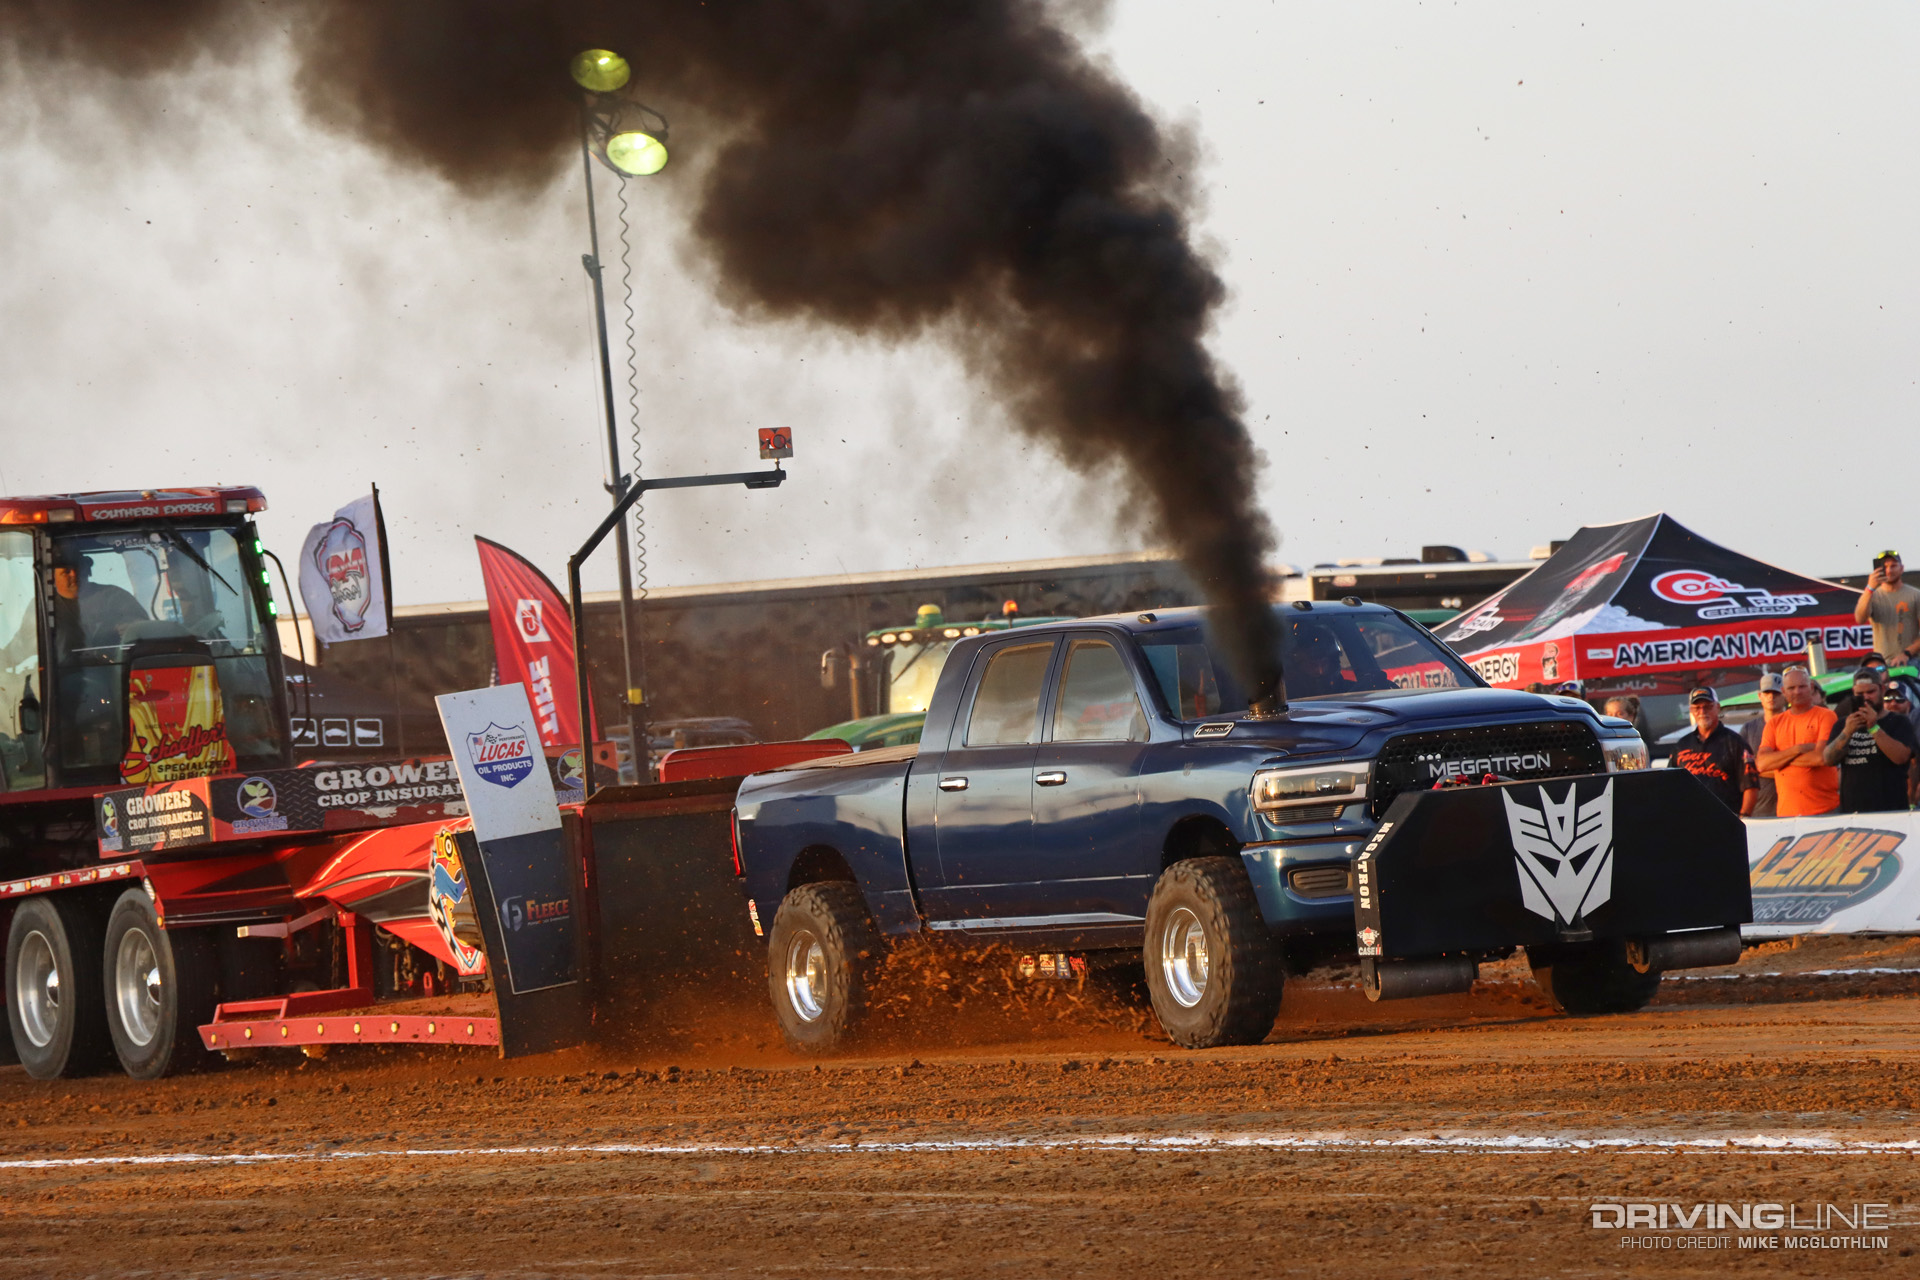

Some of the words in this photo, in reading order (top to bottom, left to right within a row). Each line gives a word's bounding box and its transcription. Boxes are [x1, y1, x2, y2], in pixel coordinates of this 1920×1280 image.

[91, 505, 160, 521] SOUTHERN
[163, 502, 216, 516] EXPRESS
[1702, 604, 1793, 619] ENERGY
[1613, 634, 1744, 667] AMERICAN
[1471, 653, 1520, 684] NERGY
[479, 740, 526, 762] LUCAS
[157, 760, 231, 773] SPECIALIZED
[478, 766, 492, 775] OIL
[492, 760, 532, 772] PRODUCTS
[1429, 753, 1551, 778] MEGATRON
[500, 773, 517, 783] INC.
[126, 790, 192, 816] GROWERS
[317, 792, 370, 807] CROP
[128, 817, 148, 830] CROP
[149, 810, 193, 828] INSURANCE
[1357, 822, 1394, 909] MEGATRON
[526, 899, 569, 921] FLEECE
